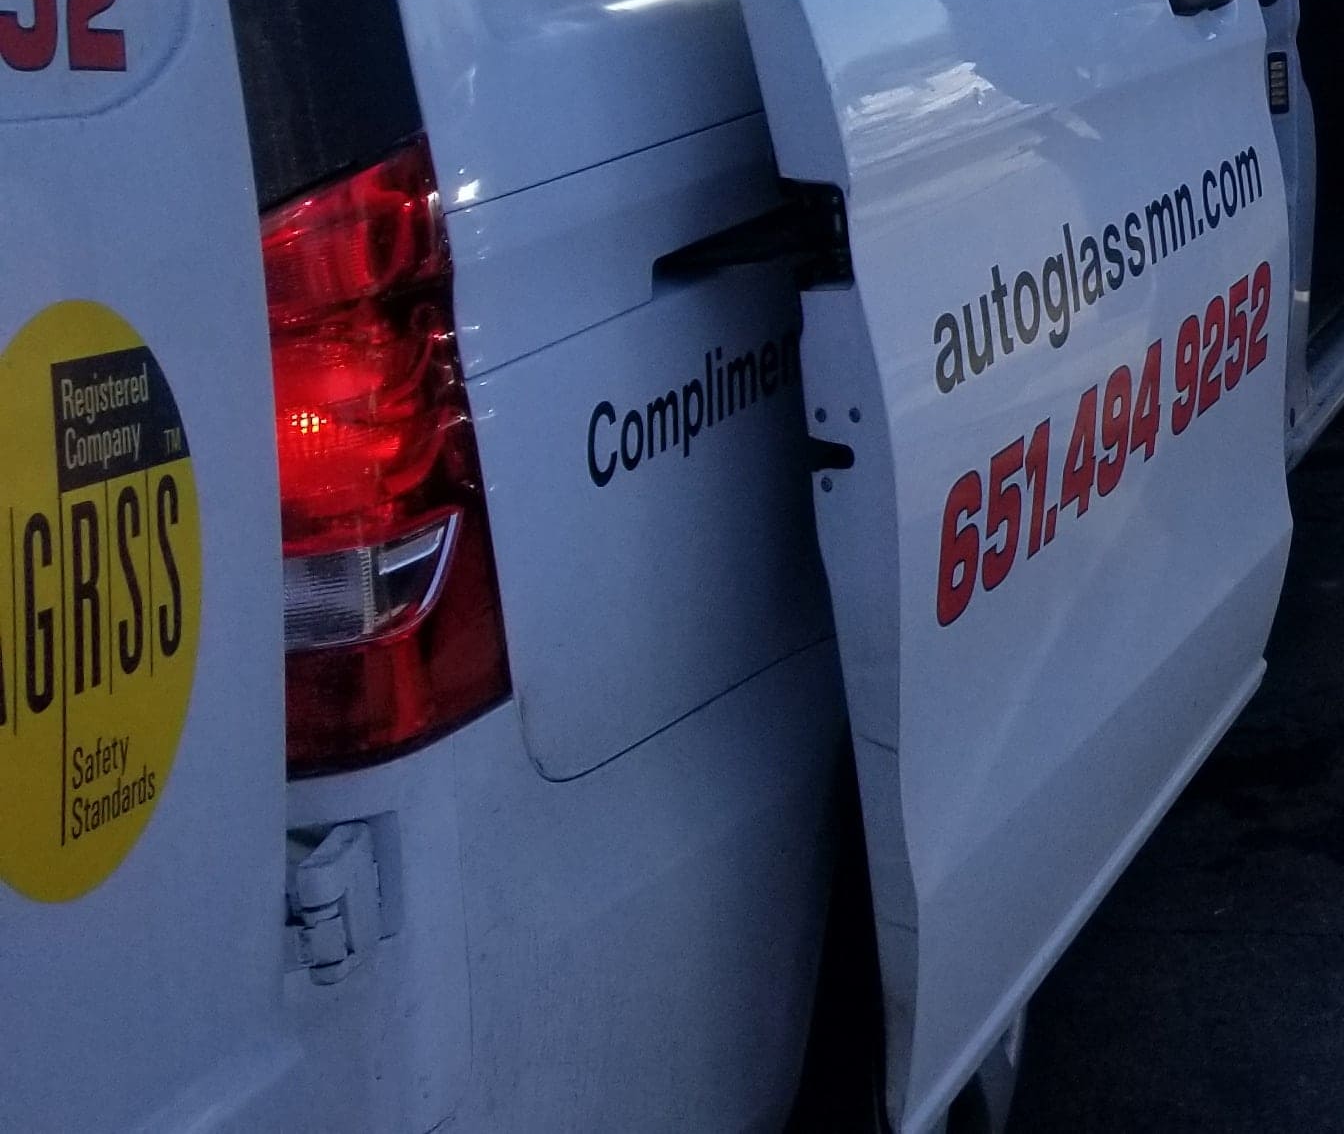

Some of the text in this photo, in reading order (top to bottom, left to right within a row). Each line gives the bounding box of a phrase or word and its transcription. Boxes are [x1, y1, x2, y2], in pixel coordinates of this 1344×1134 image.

[934, 146, 1264, 395] autoglassmn.com
[60, 362, 150, 424] Registered
[64, 422, 142, 470] Company
[936, 261, 1272, 628] 651.494 9252
[0, 474, 182, 727] GRSS
[71, 735, 130, 791] Safety
[71, 764, 157, 841] Standards
